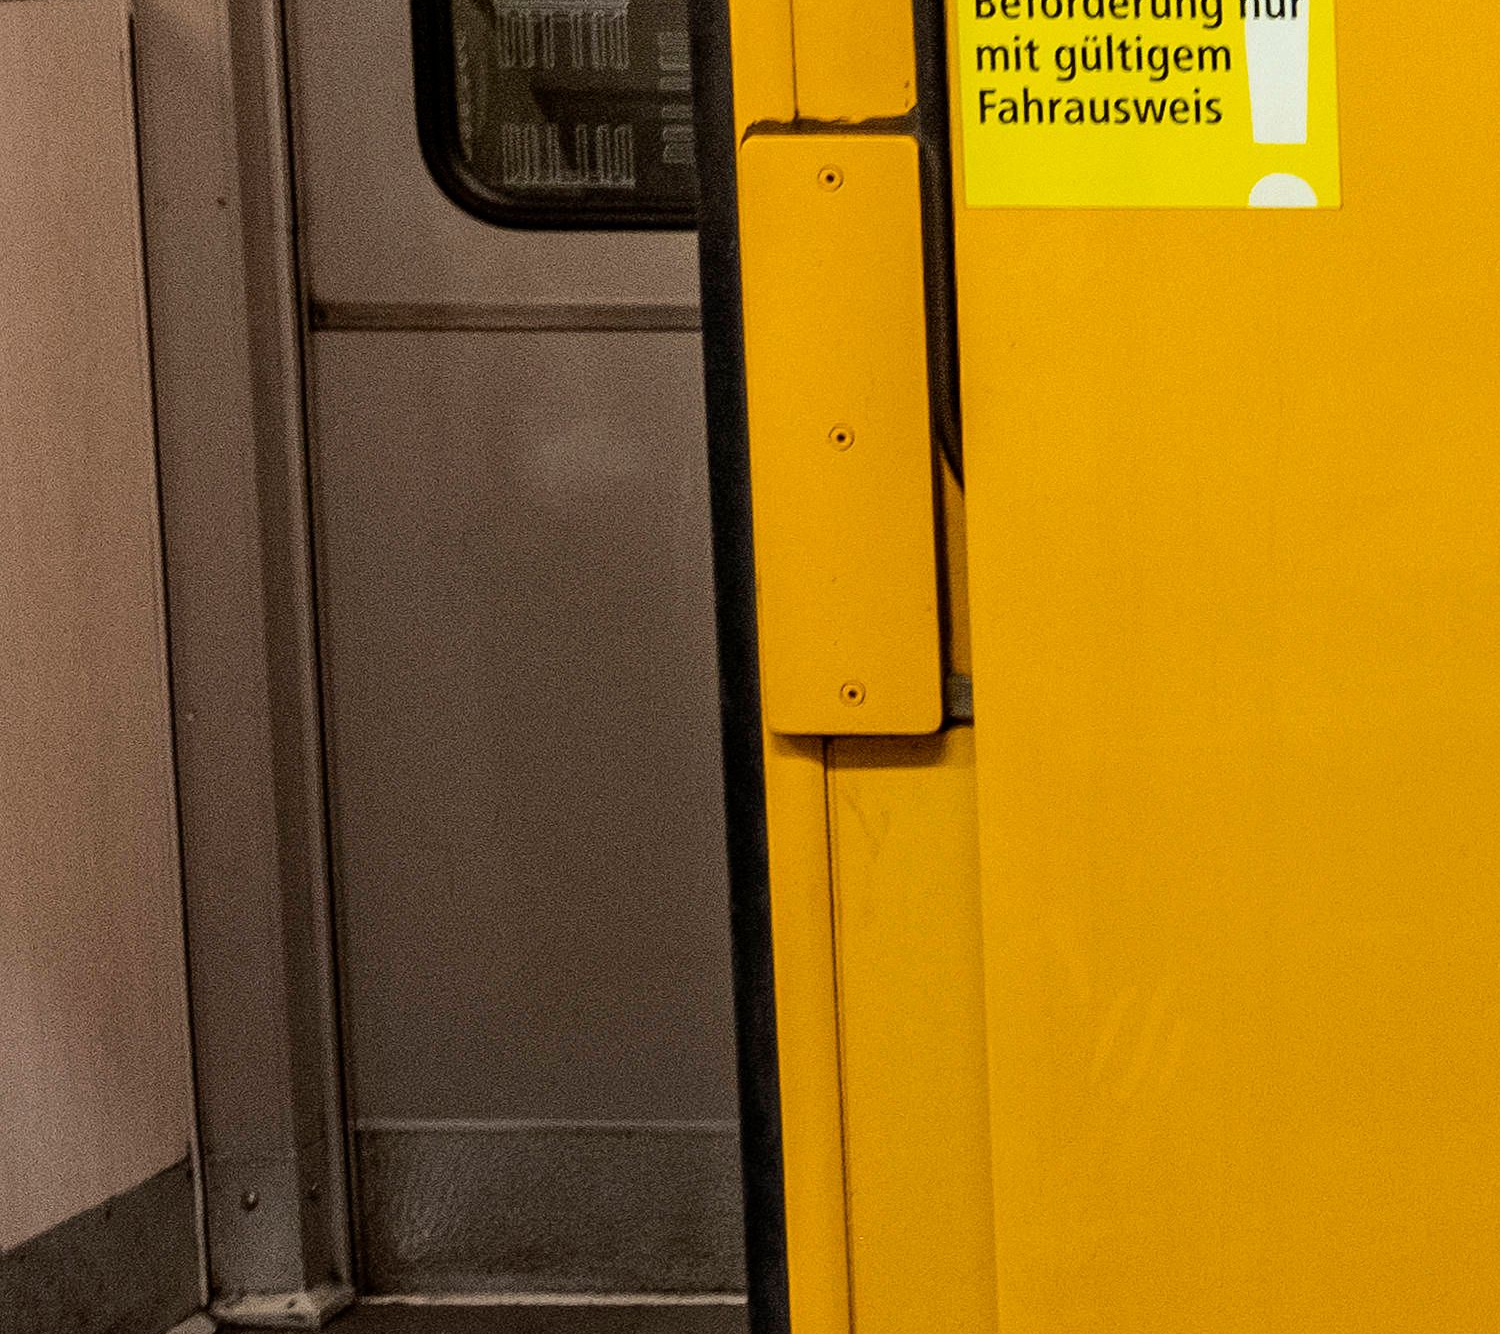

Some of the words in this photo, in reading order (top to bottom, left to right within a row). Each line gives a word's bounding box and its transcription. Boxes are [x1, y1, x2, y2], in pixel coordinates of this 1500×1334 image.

[976, 34, 1040, 73] mit
[1054, 33, 1232, 83] gültigem
[978, 87, 1223, 127] Fahrausweis
